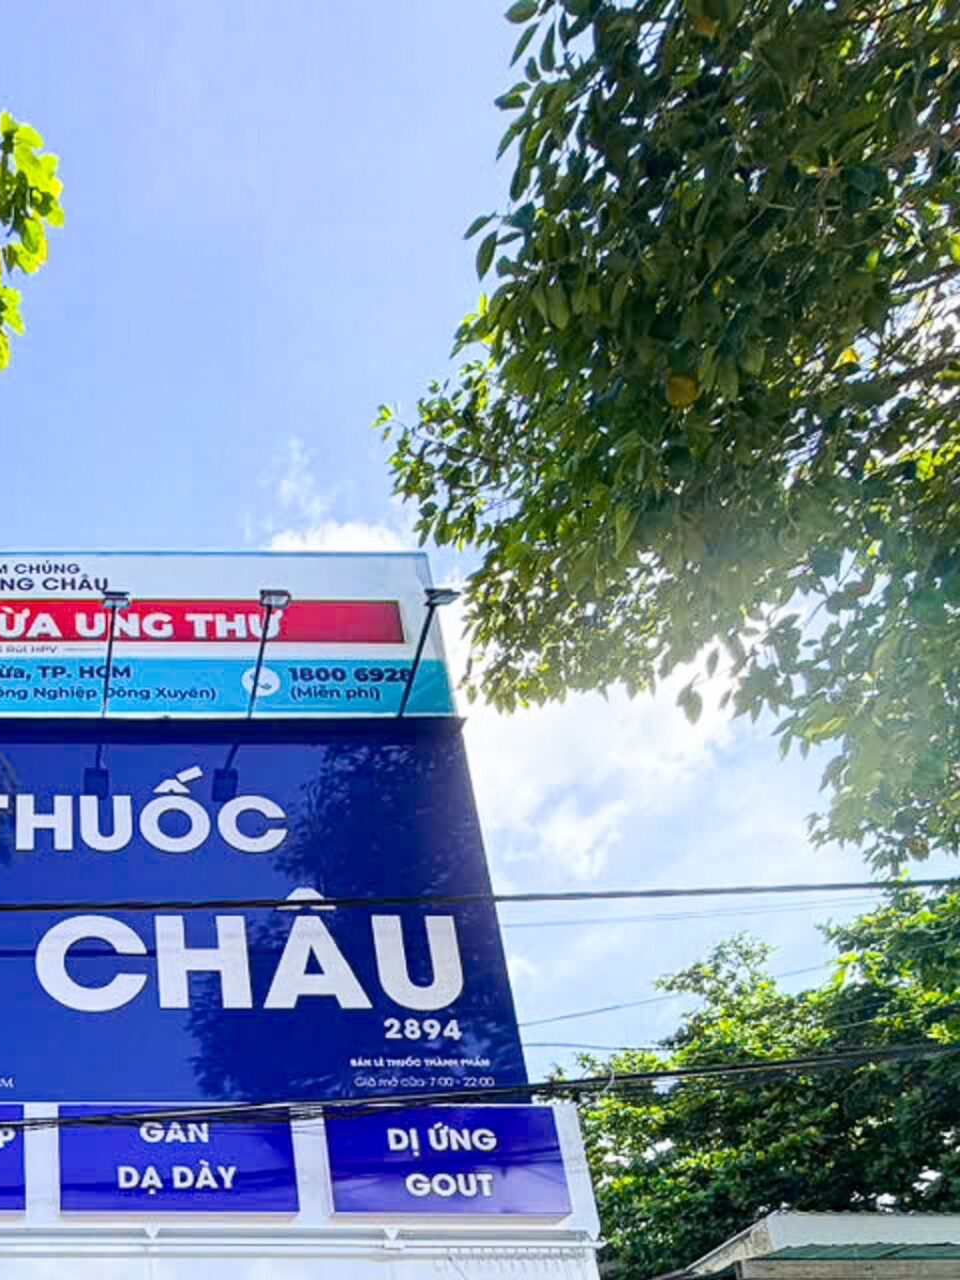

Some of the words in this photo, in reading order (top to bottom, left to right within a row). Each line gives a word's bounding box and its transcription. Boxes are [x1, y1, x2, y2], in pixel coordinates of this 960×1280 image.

[42, 574, 109, 591] CHÂU
[75, 612, 174, 639] UNG
[185, 609, 283, 639] THƯ
[40, 666, 71, 679] TP.
[80, 666, 131, 680] HCM
[288, 667, 346, 682] 1800
[353, 667, 412, 682] 6928
[39, 685, 97, 701] Nghiệp
[346, 686, 380, 700] phí)
[36, 887, 464, 1012] CHÂU
[383, 1018, 462, 1040] 2894
[387, 1128, 419, 1157] DỊ
[427, 1121, 497, 1151] ỨNG
[118, 1166, 163, 1195] DẠ
[172, 1160, 236, 1189] DÀY
[405, 1173, 493, 1197] GOUT
